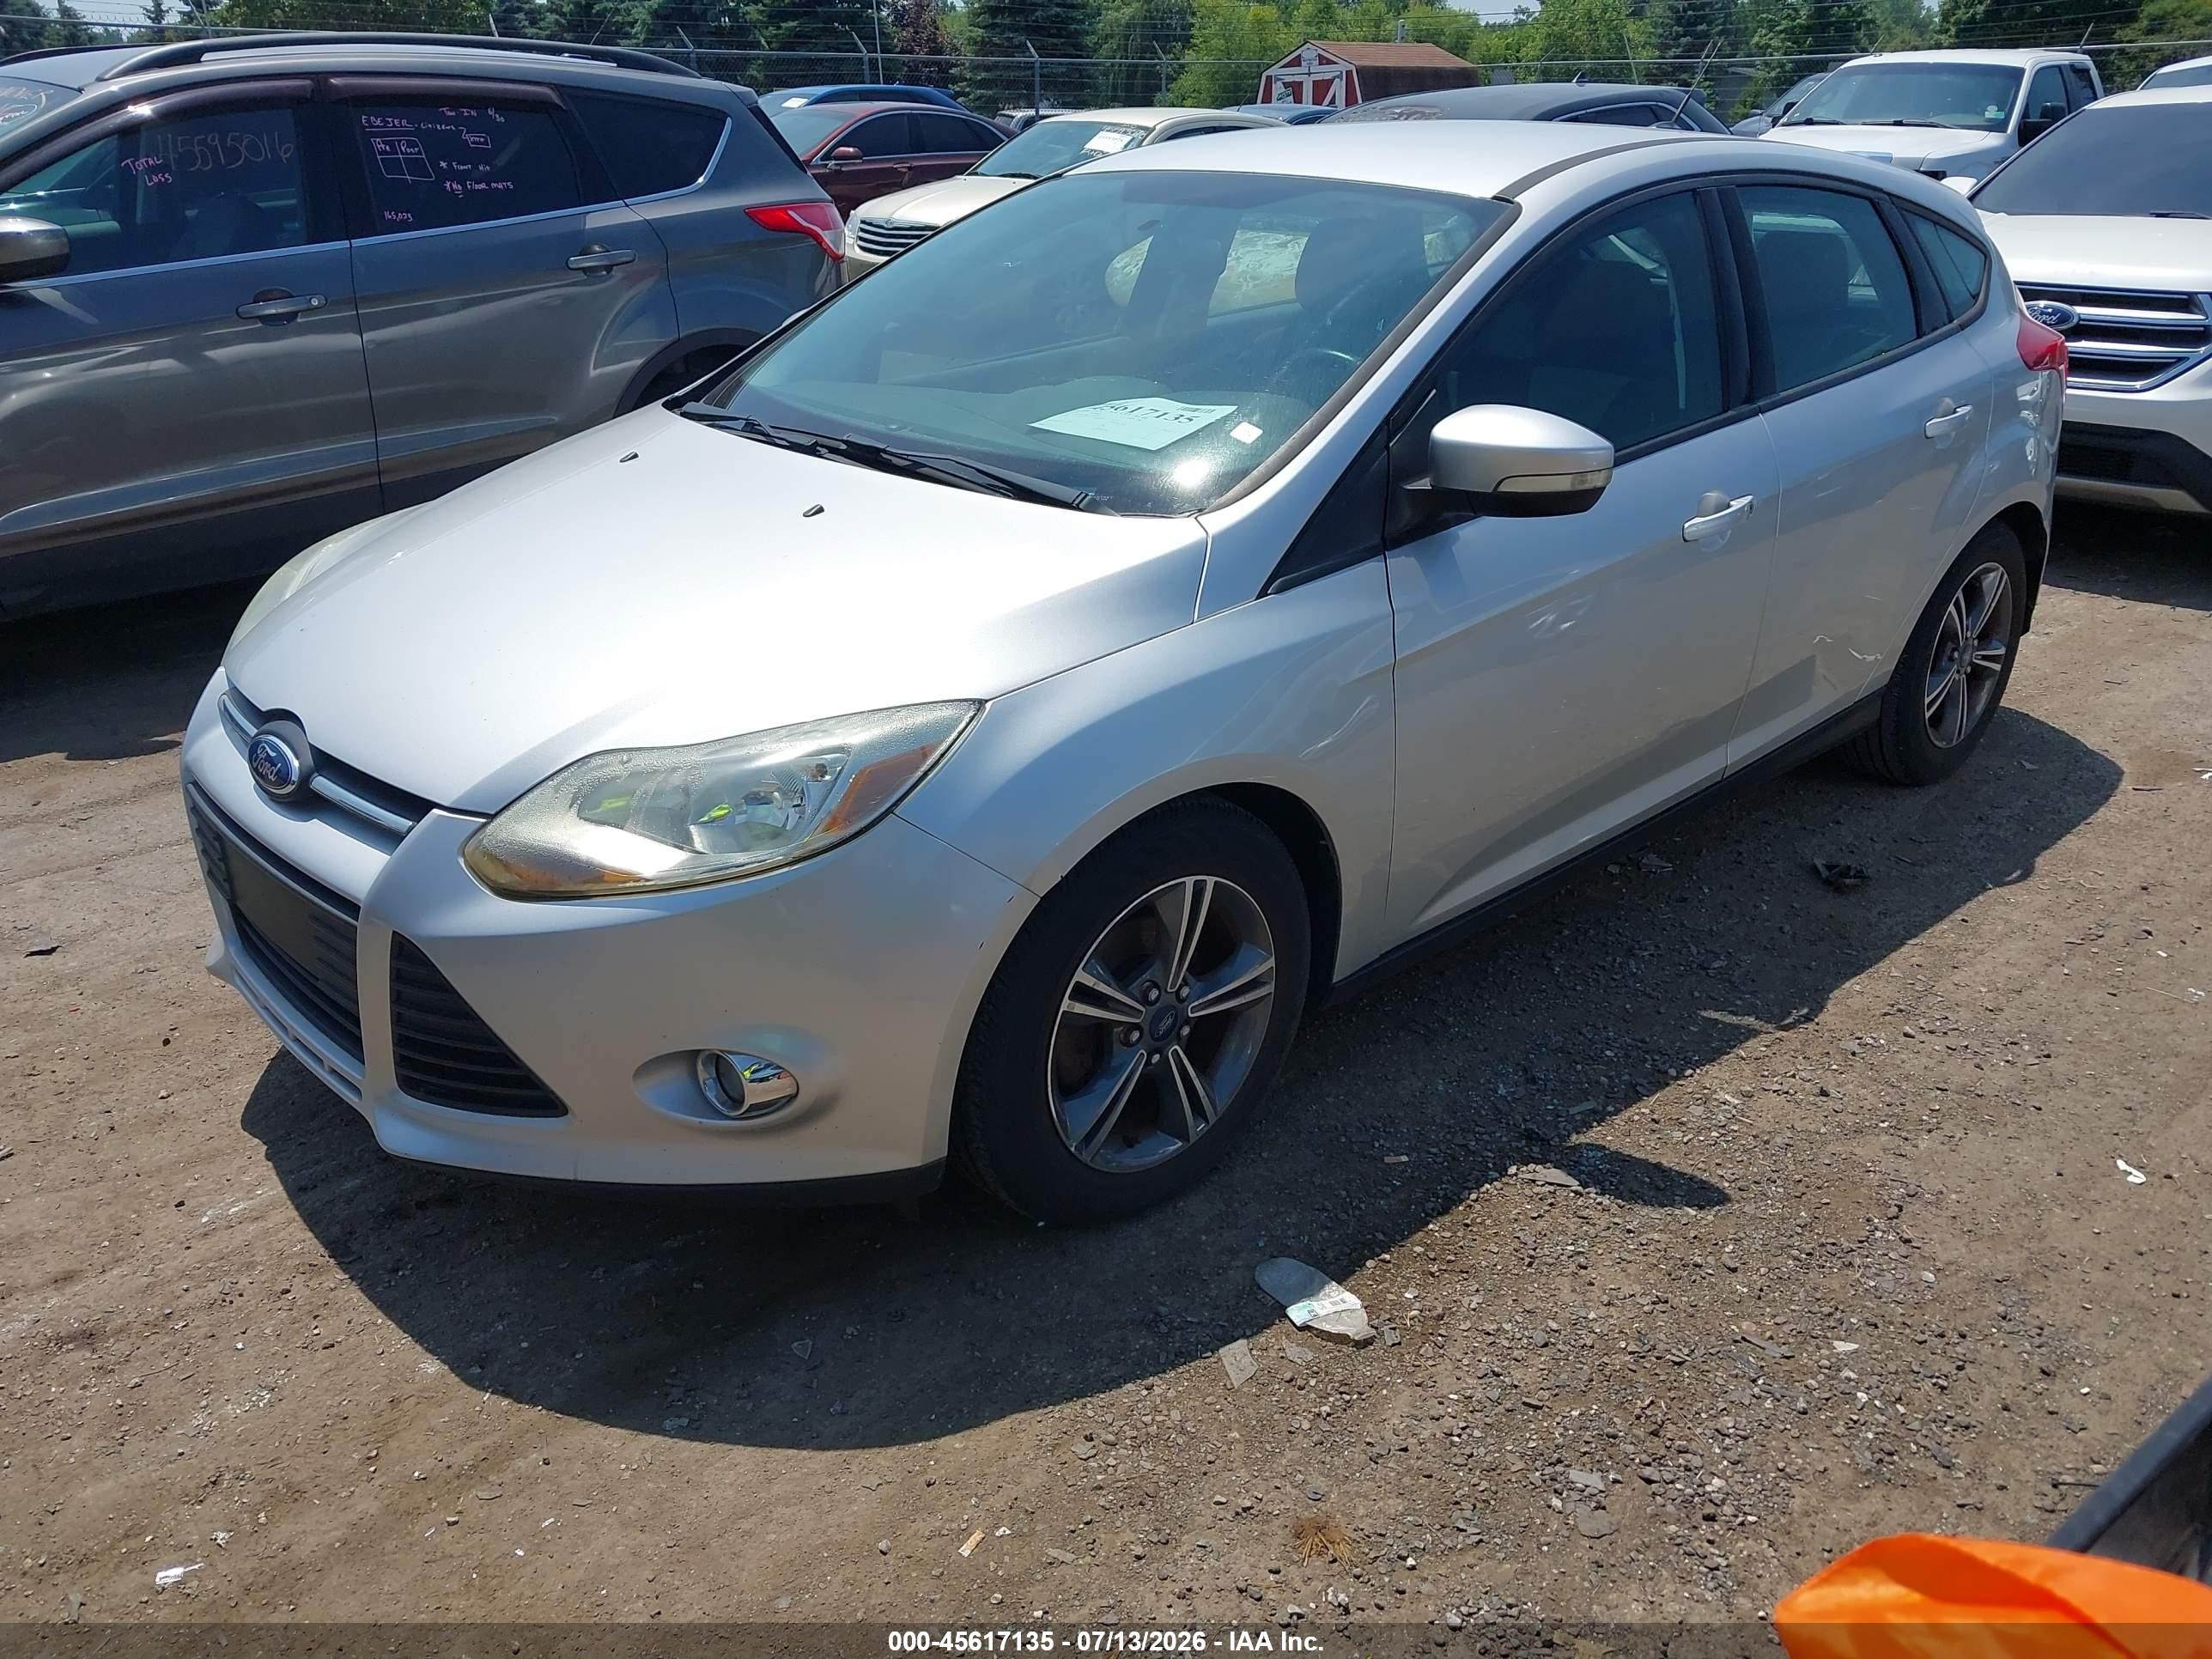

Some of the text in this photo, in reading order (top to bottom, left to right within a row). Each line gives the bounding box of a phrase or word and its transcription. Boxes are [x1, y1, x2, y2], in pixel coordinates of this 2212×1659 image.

[157, 131, 295, 171] 45595016
[121, 155, 163, 174] TOTAL
[144, 173, 173, 186] LOSS
[2027, 306, 2062, 325] Ford
[252, 743, 282, 781] Ford
